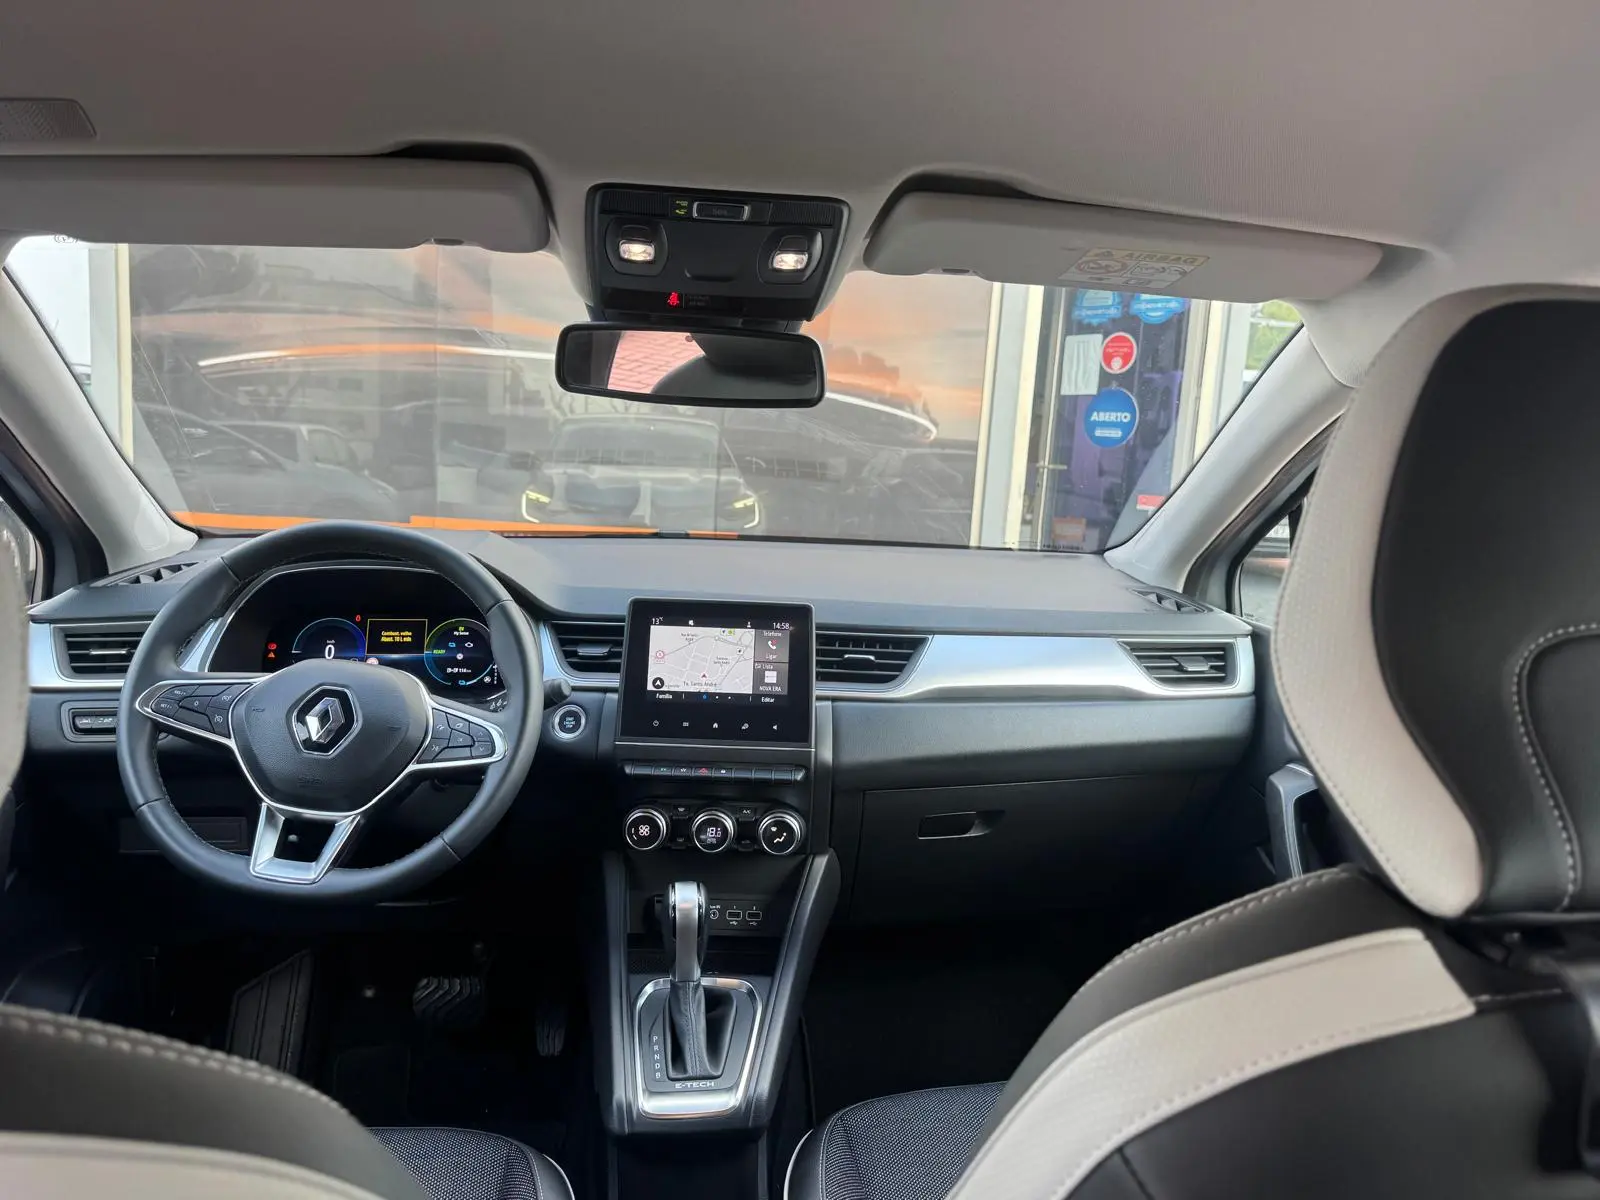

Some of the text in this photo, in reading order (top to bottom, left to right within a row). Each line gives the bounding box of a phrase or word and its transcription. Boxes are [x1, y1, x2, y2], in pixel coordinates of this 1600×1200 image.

[1124, 252, 1199, 263] AIRBAG
[1090, 411, 1131, 422] ABERTO
[772, 622, 790, 630] 14:58
[325, 644, 335, 660] 0
[653, 1035, 658, 1043] P
[675, 1081, 714, 1089] E-TECH
